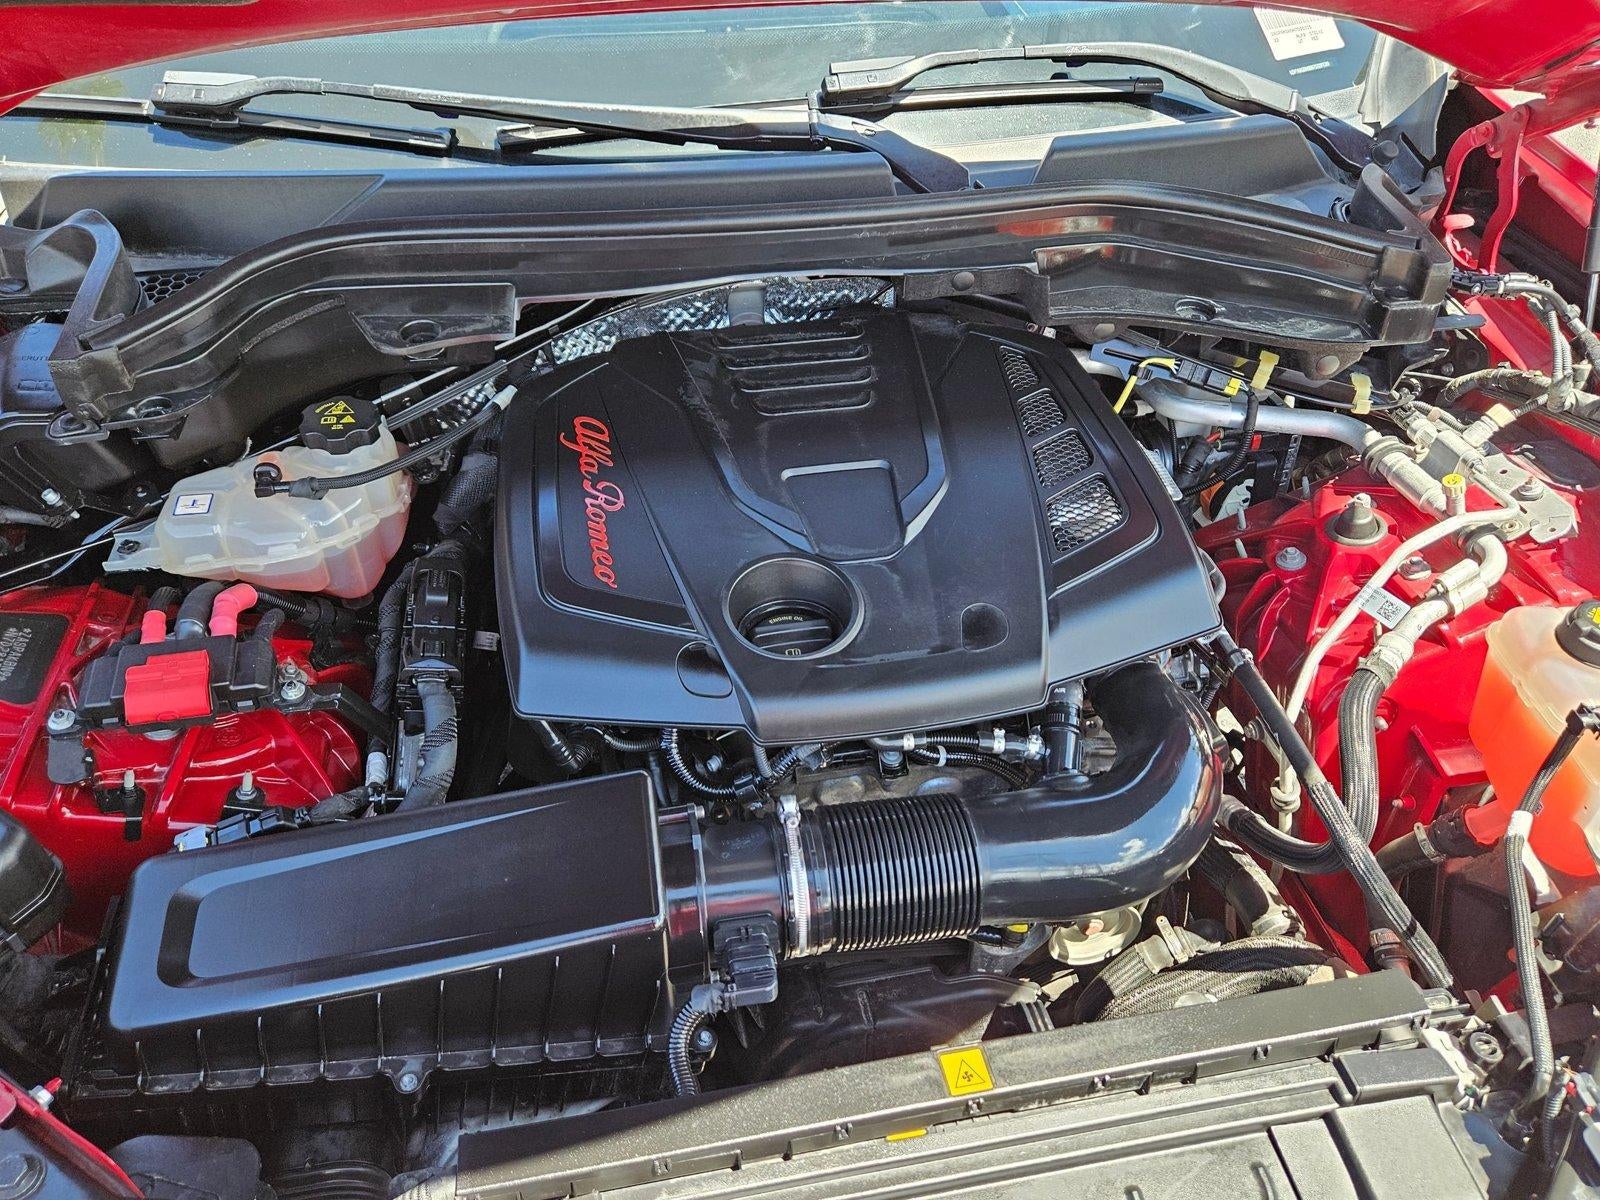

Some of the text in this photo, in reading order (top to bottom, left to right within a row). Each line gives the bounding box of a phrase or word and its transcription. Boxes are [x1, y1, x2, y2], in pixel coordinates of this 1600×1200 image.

[559, 415, 626, 589] Alfa Romeo
[768, 615, 793, 625] ENGINE
